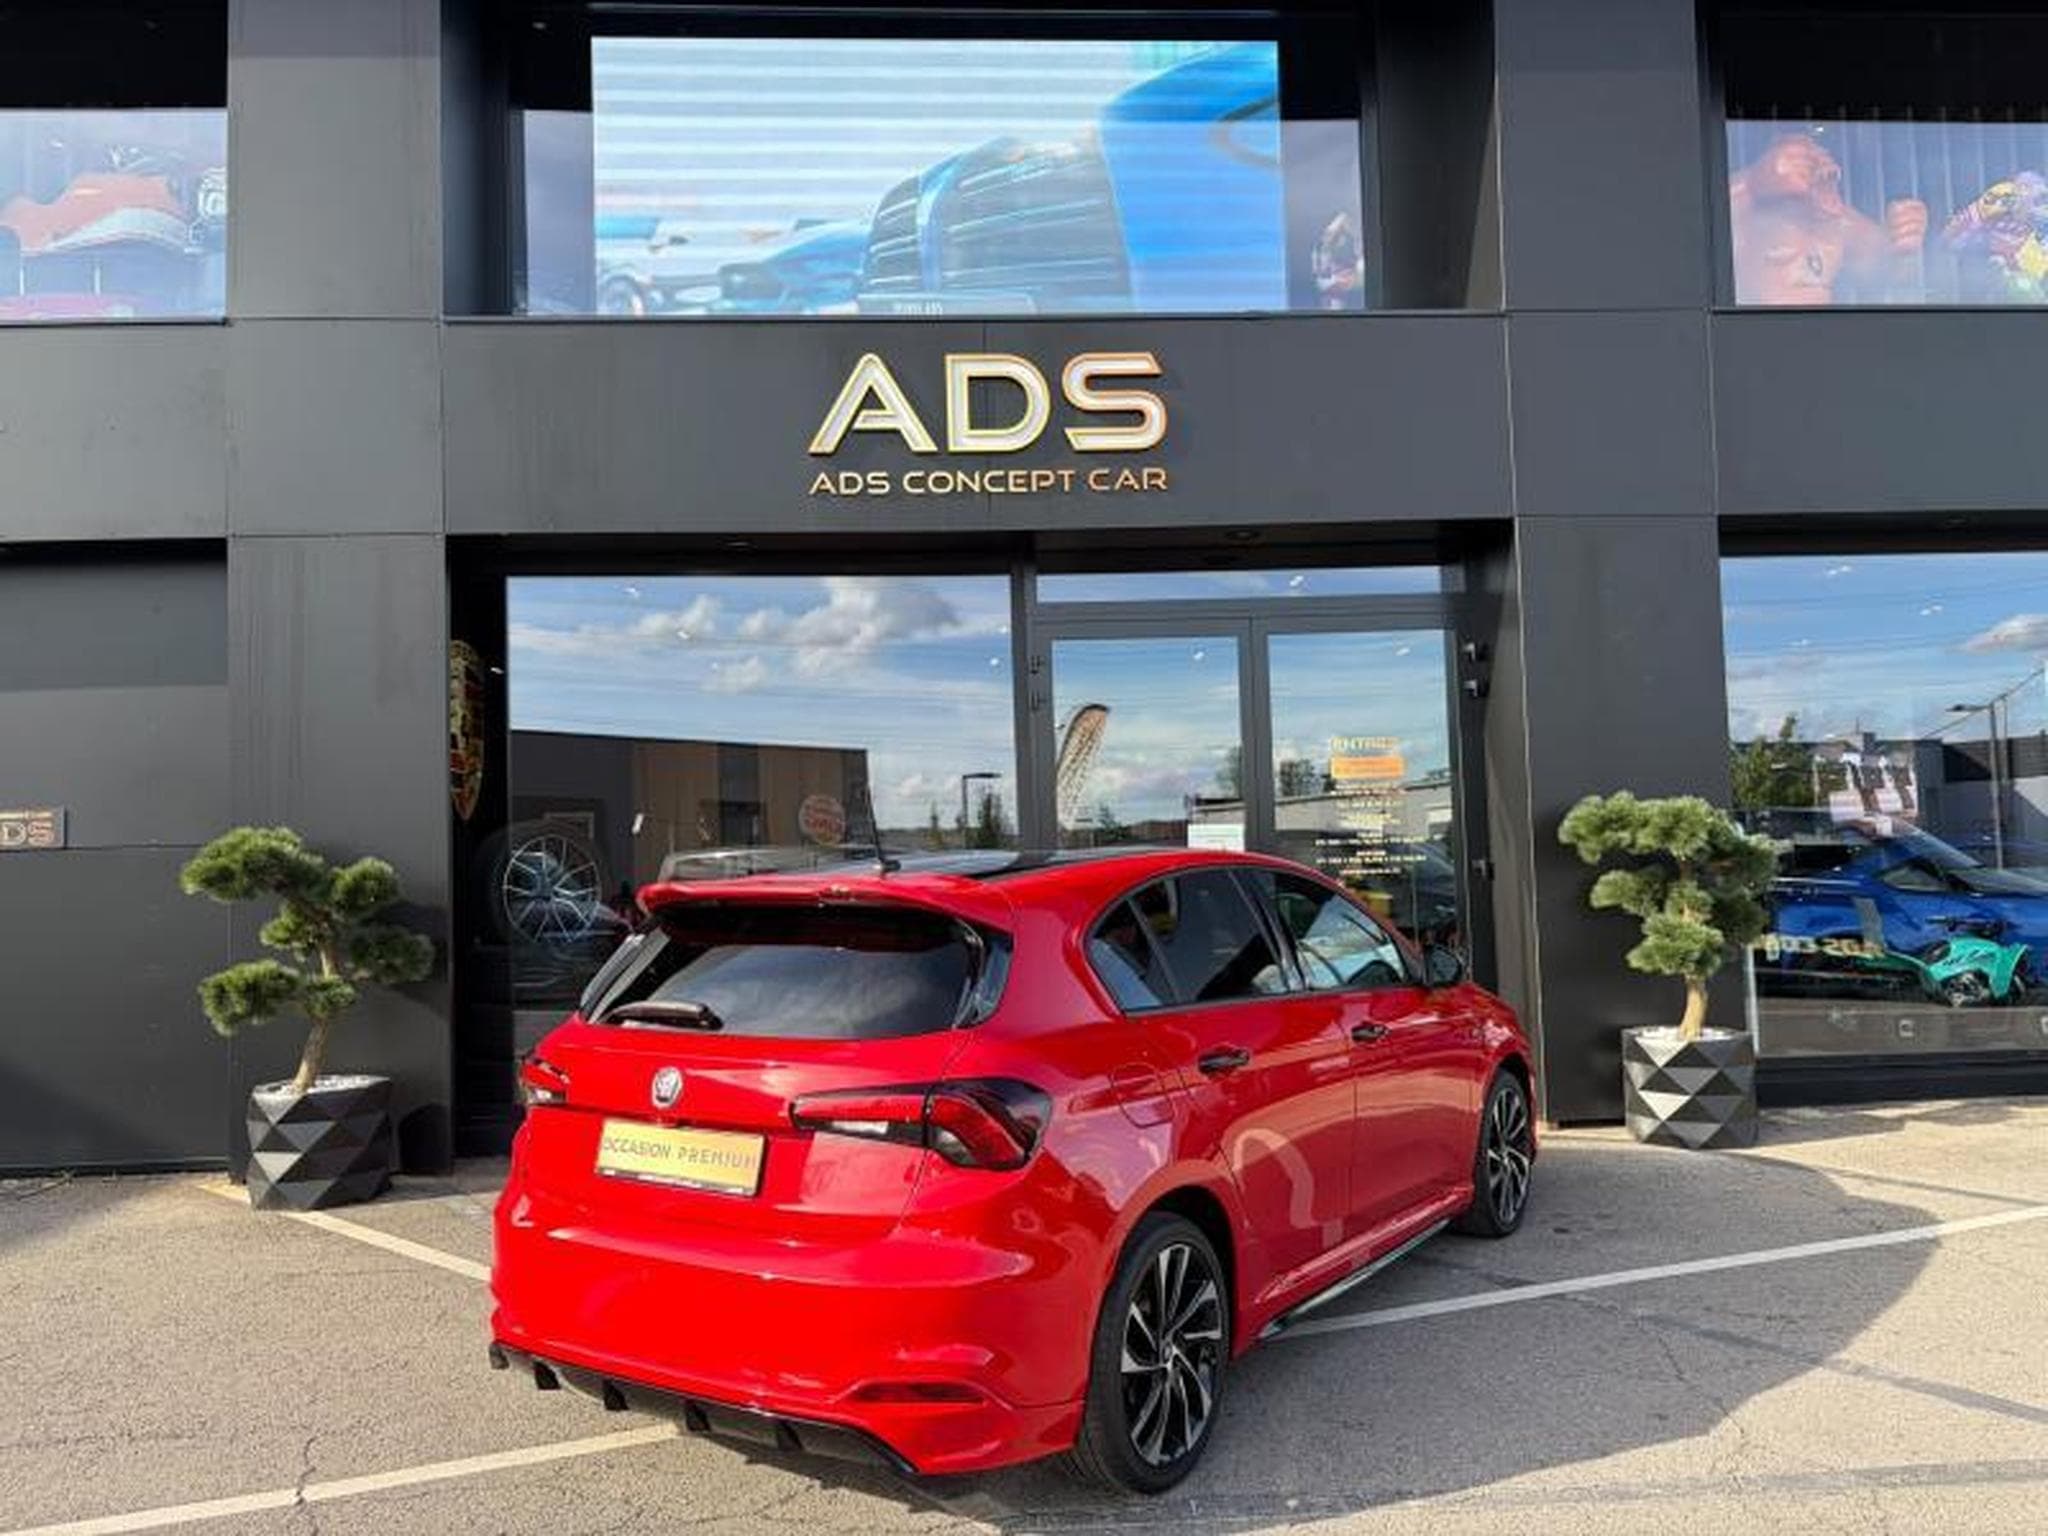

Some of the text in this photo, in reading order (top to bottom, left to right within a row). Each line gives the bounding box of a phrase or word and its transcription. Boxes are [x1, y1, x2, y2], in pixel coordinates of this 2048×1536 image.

[809, 352, 1168, 454] ADS
[809, 467, 1169, 496] ADS CONCEPT CAR
[0, 819, 55, 847] DS
[603, 1137, 757, 1169] OCCASION PREMIUM
